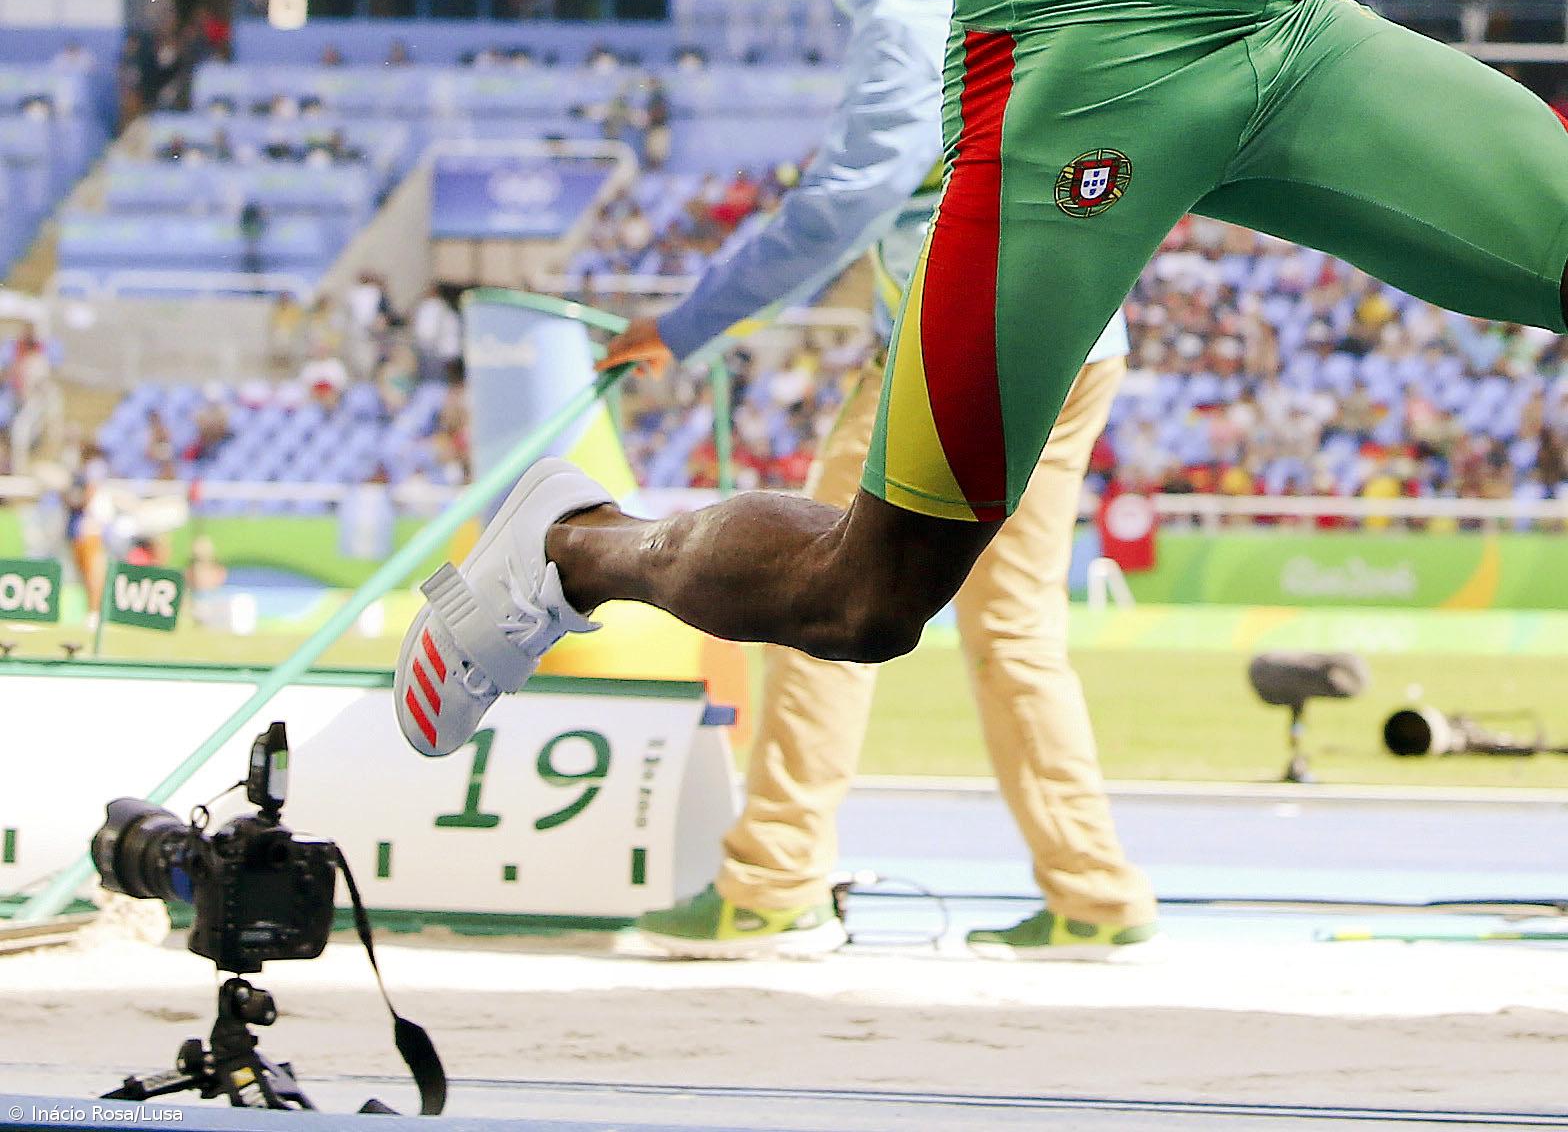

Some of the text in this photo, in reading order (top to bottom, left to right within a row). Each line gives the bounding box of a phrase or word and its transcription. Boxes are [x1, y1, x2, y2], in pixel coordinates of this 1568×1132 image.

[0, 573, 52, 613] OR
[114, 574, 177, 617] WR
[434, 727, 611, 830] 19
